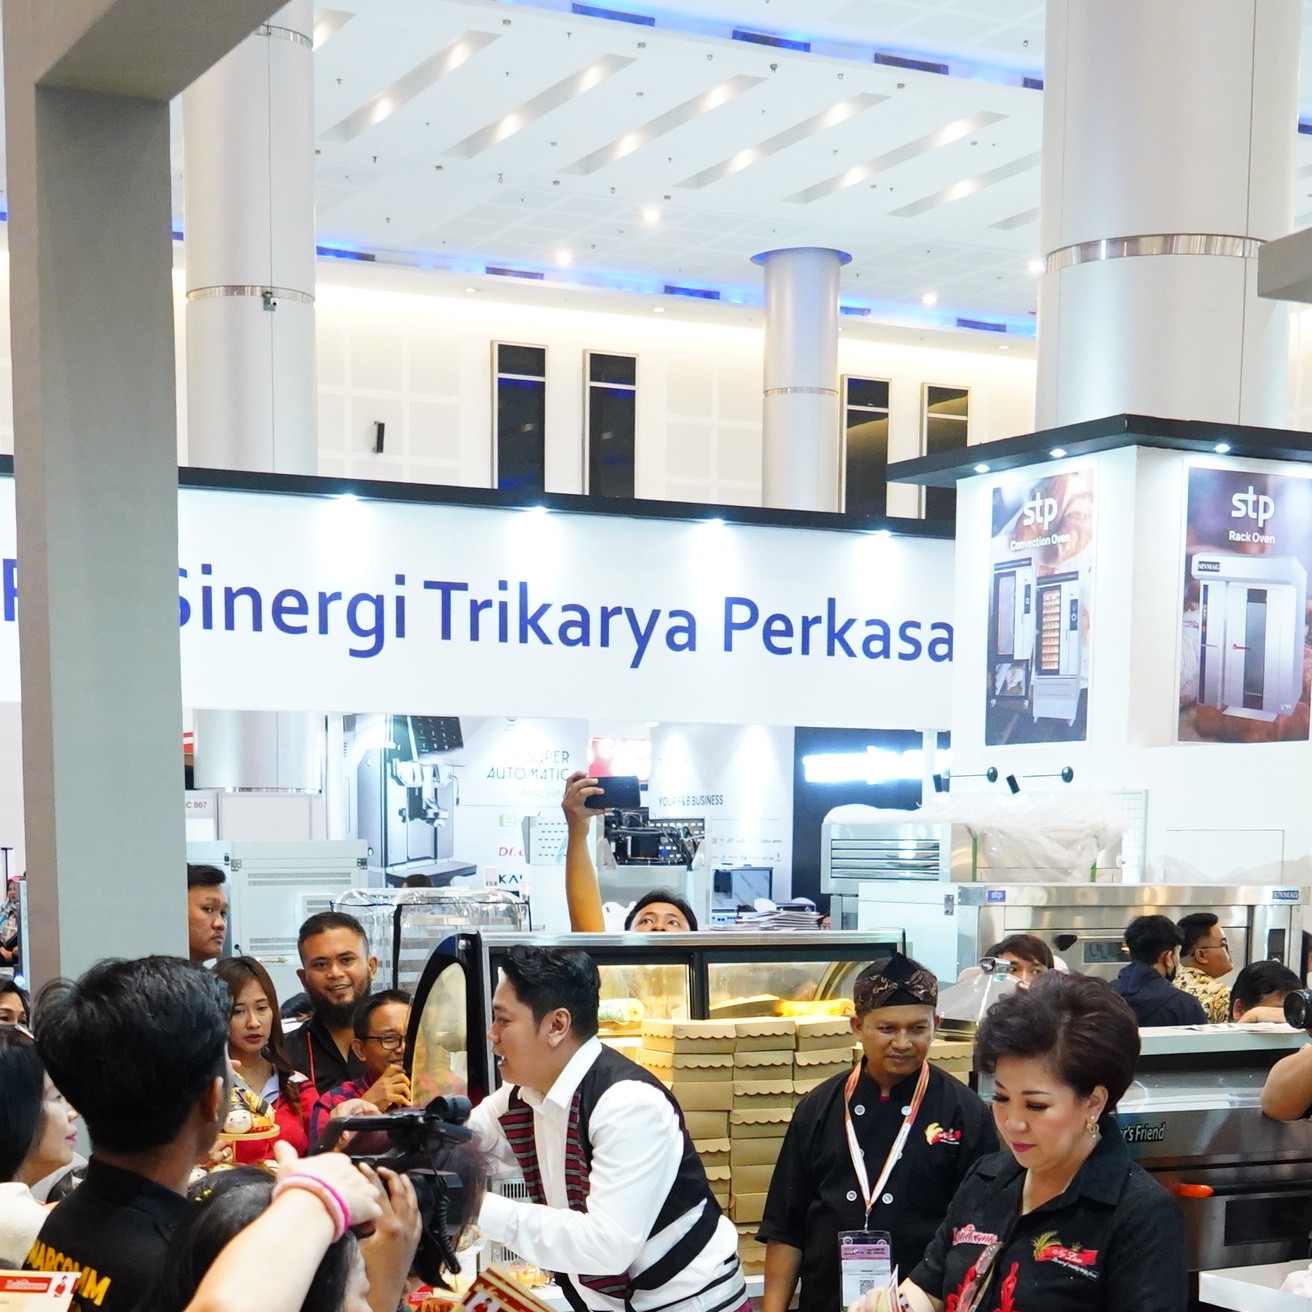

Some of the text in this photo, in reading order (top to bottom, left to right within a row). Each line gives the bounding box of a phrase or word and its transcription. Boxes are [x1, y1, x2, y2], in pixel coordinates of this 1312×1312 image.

[1022, 491, 1059, 531] stp
[1231, 485, 1275, 528] stp
[1009, 532, 1072, 552] Convection Oven
[1228, 530, 1276, 544] Rack Oven
[423, 579, 698, 670] Trikarya
[722, 596, 954, 663] Perkasa
[486, 766, 571, 782] AUTOMATIC
[522, 788, 564, 801] MACHIN
[691, 794, 724, 806] BUSINESS
[193, 801, 208, 809] 007
[1135, 1121, 1166, 1141] Friend
